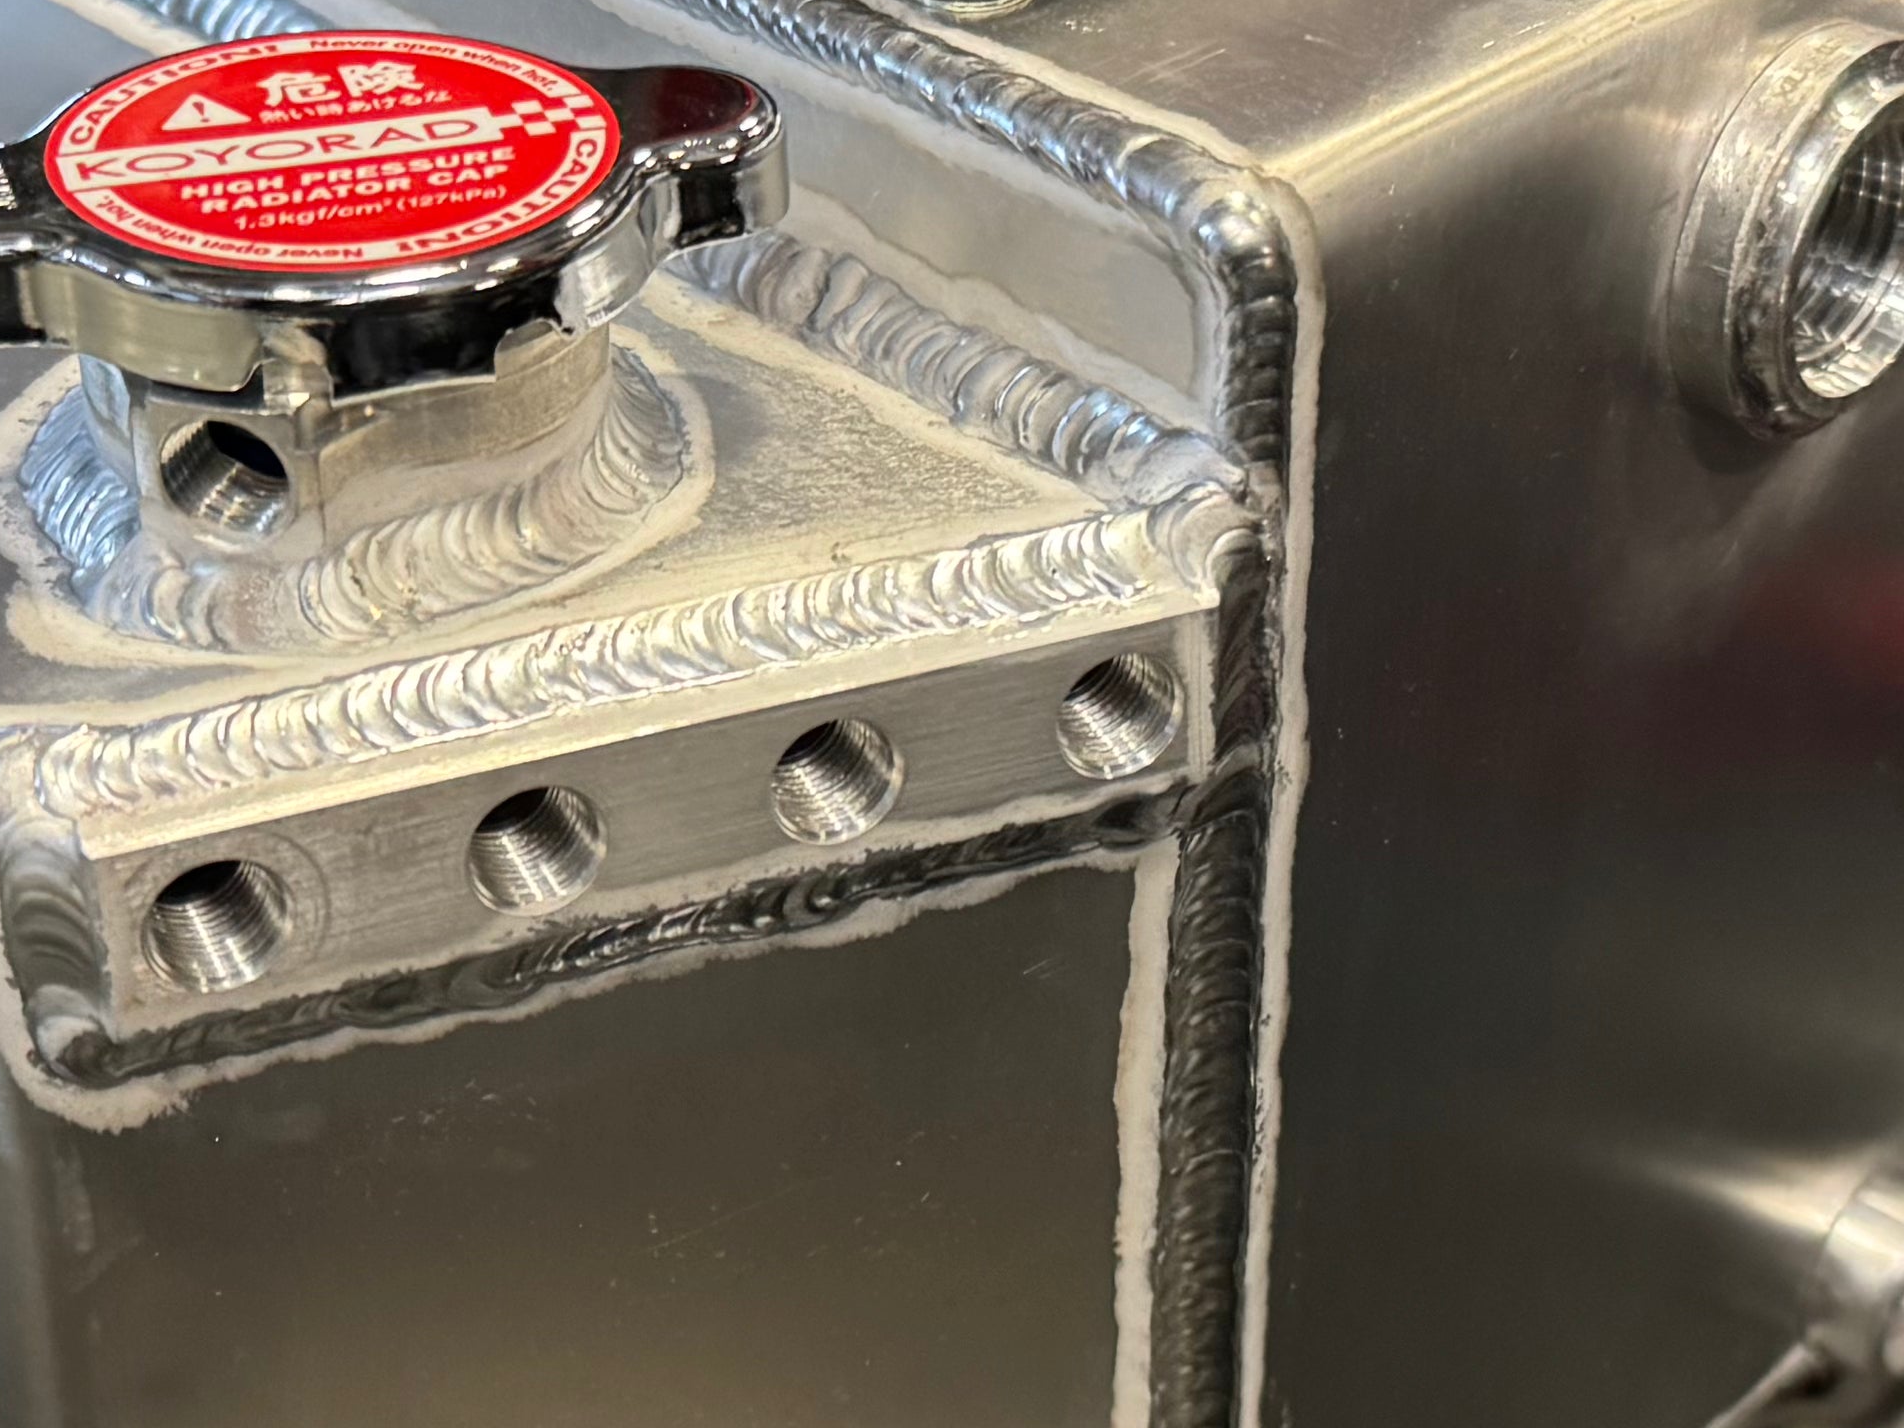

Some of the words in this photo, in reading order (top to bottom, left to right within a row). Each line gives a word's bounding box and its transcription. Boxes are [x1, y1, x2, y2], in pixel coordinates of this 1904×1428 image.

[70, 45, 279, 144] CAUTION!
[309, 39, 388, 49] Never
[393, 42, 456, 56] open
[463, 51, 522, 73] when
[256, 61, 425, 107] 危険
[76, 120, 478, 181] KOYORAD
[181, 175, 284, 200] HIGH
[300, 146, 515, 187] PRESSURE
[201, 177, 412, 213] RADIATOR
[427, 165, 508, 187] CAP
[397, 138, 596, 252] CAUTION!
[143, 221, 197, 245] when
[201, 240, 271, 256] open
[277, 248, 364, 259] Never
